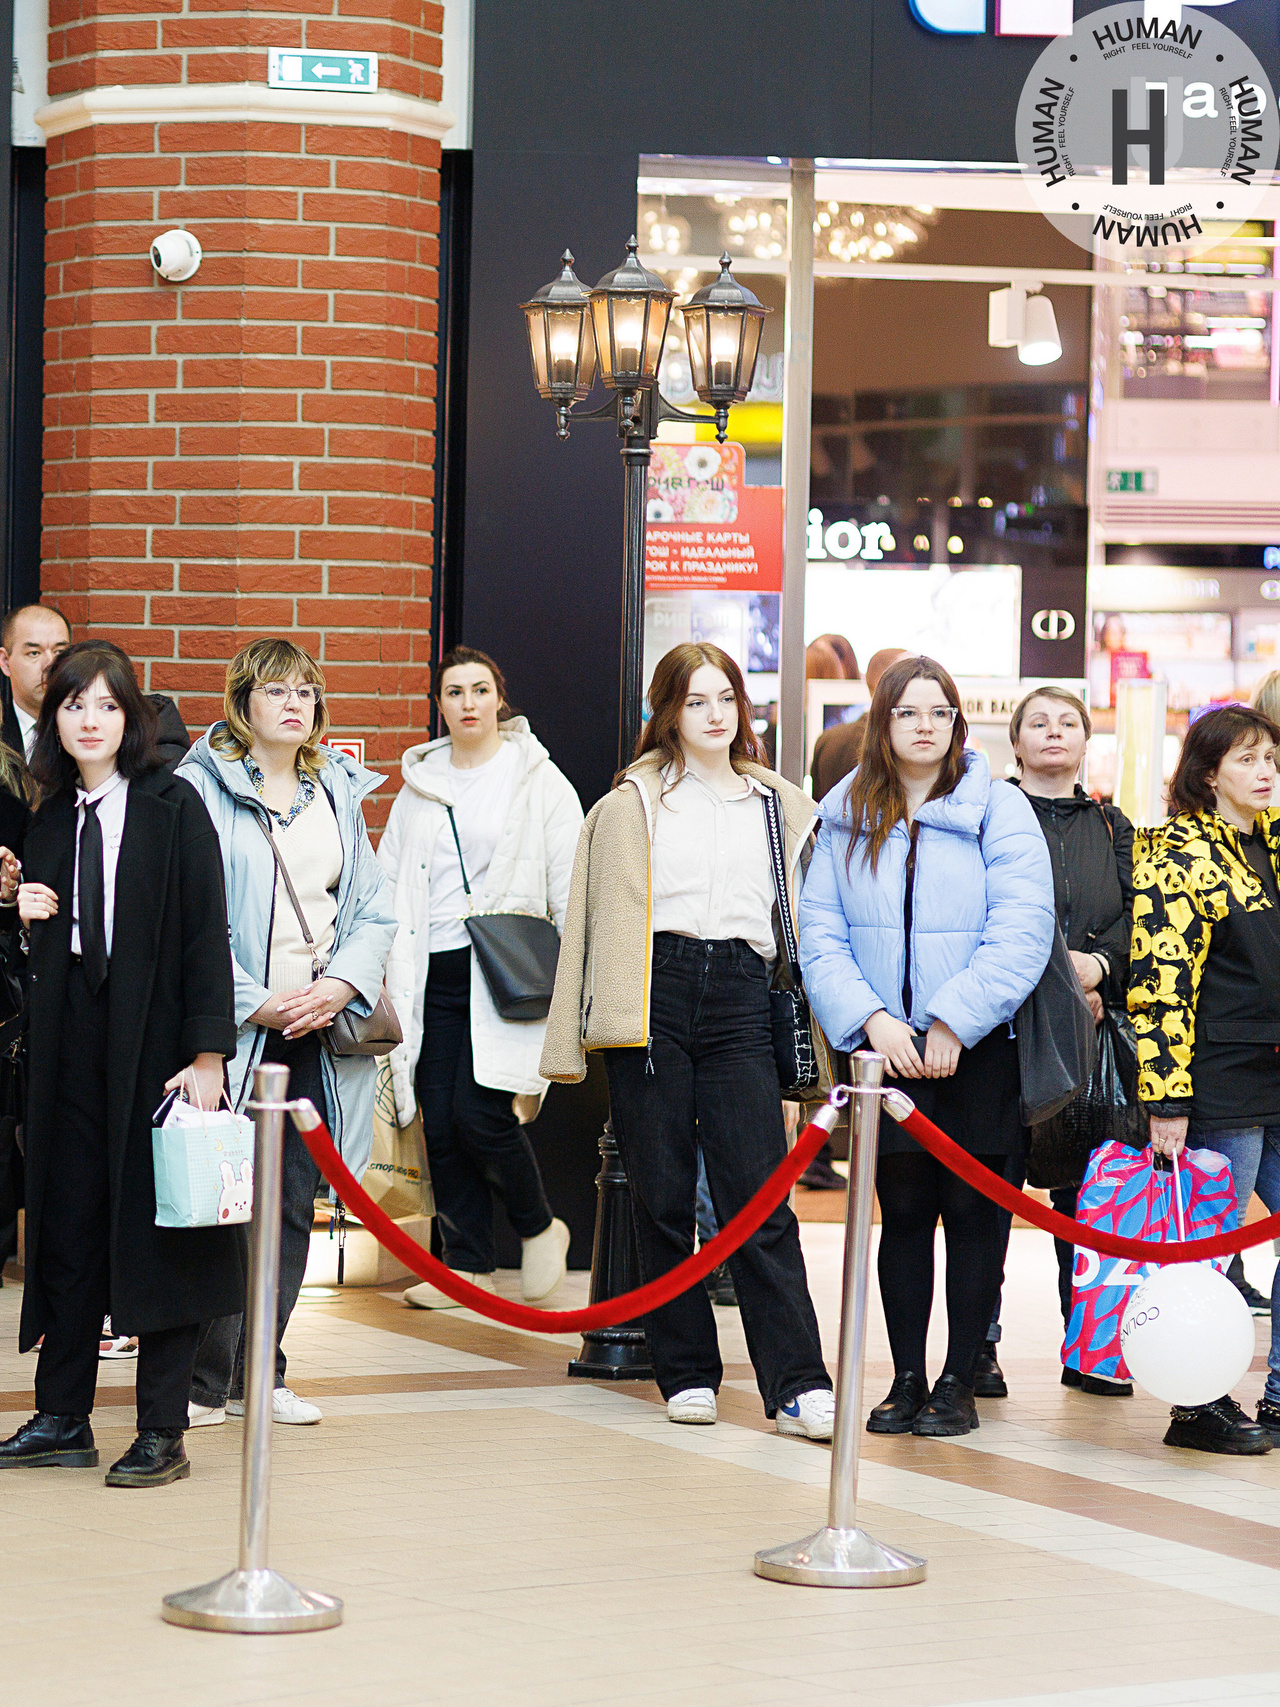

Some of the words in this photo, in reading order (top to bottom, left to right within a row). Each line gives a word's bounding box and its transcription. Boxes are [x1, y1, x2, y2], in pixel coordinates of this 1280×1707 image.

[646, 530, 704, 543] АРОЧНЫЕ
[706, 532, 750, 544] КАРТЫ
[806, 508, 891, 560] ior
[680, 545, 755, 559] ИДЕАЛЬНЫЙ
